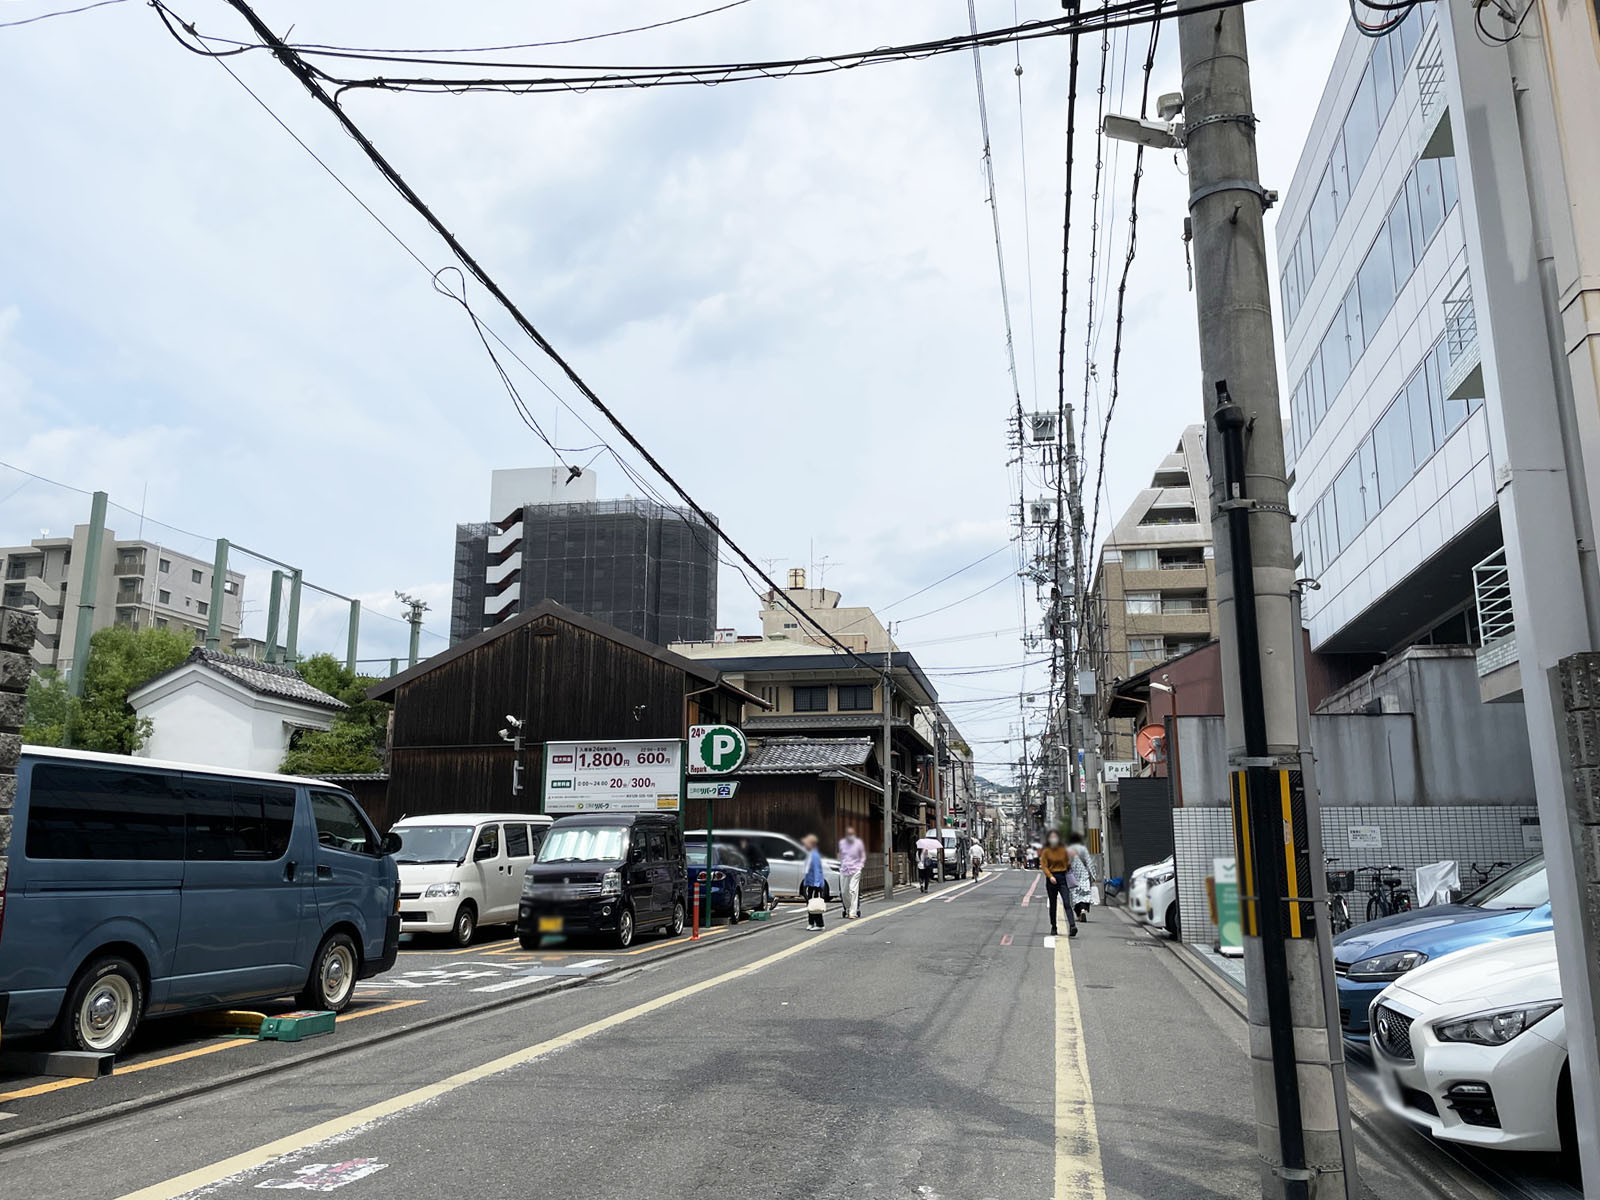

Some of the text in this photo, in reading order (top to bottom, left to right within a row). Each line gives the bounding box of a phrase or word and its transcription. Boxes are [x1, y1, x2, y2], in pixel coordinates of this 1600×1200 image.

[691, 728, 706, 738] 24h
[713, 735, 736, 766] P
[579, 752, 630, 768] 1,800円
[637, 752, 671, 765] 600円
[690, 764, 707, 773] Repark
